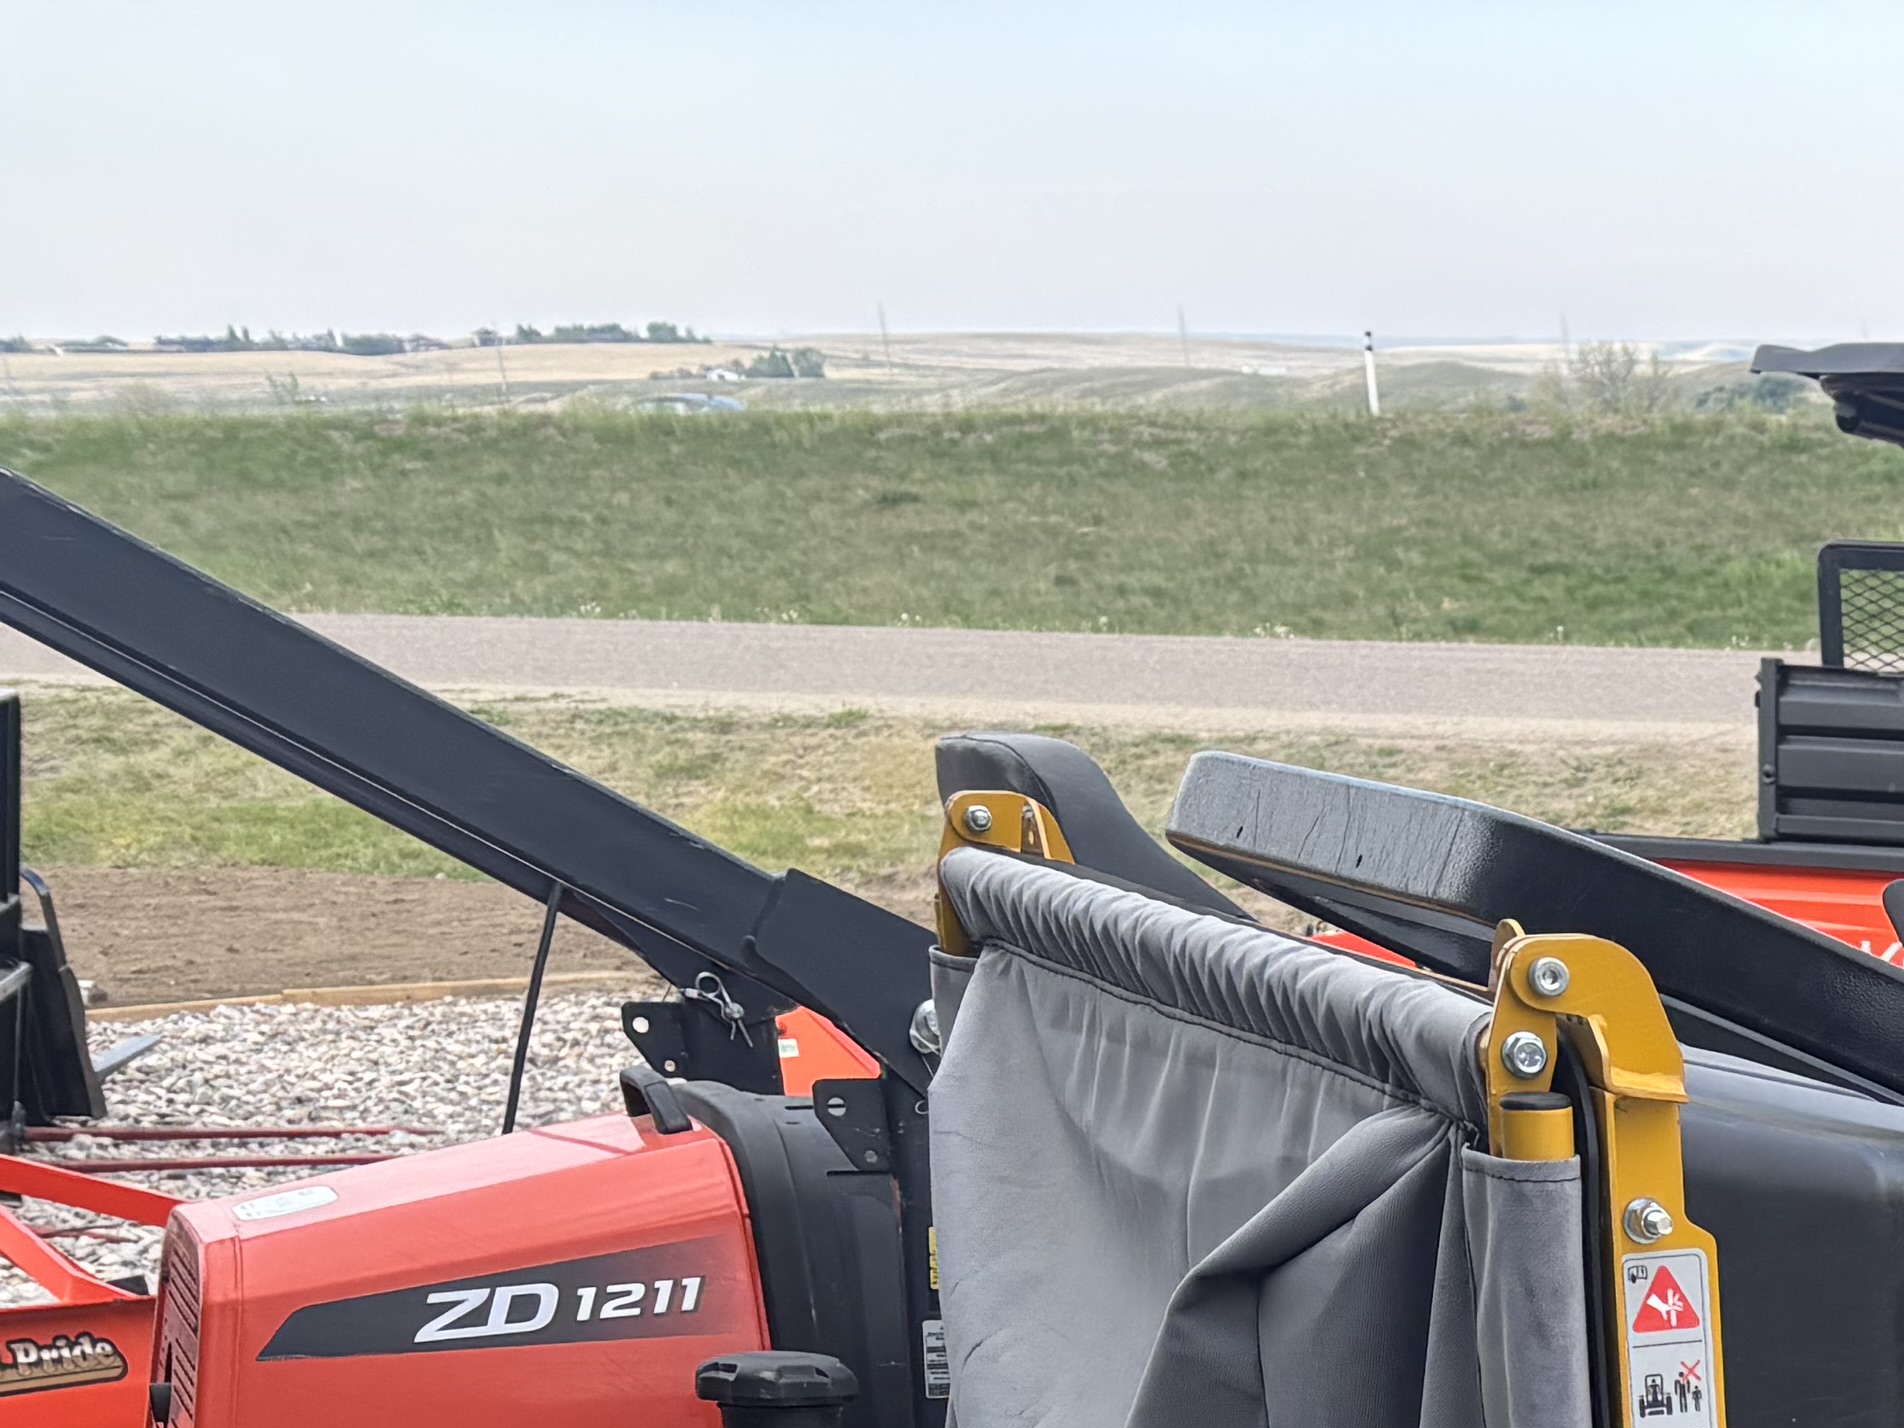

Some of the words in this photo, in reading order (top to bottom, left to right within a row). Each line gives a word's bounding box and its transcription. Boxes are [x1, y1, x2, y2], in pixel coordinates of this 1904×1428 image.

[413, 1283, 559, 1343] ZD
[576, 1277, 701, 1322] 1211
[9, 1334, 116, 1376] Pride
